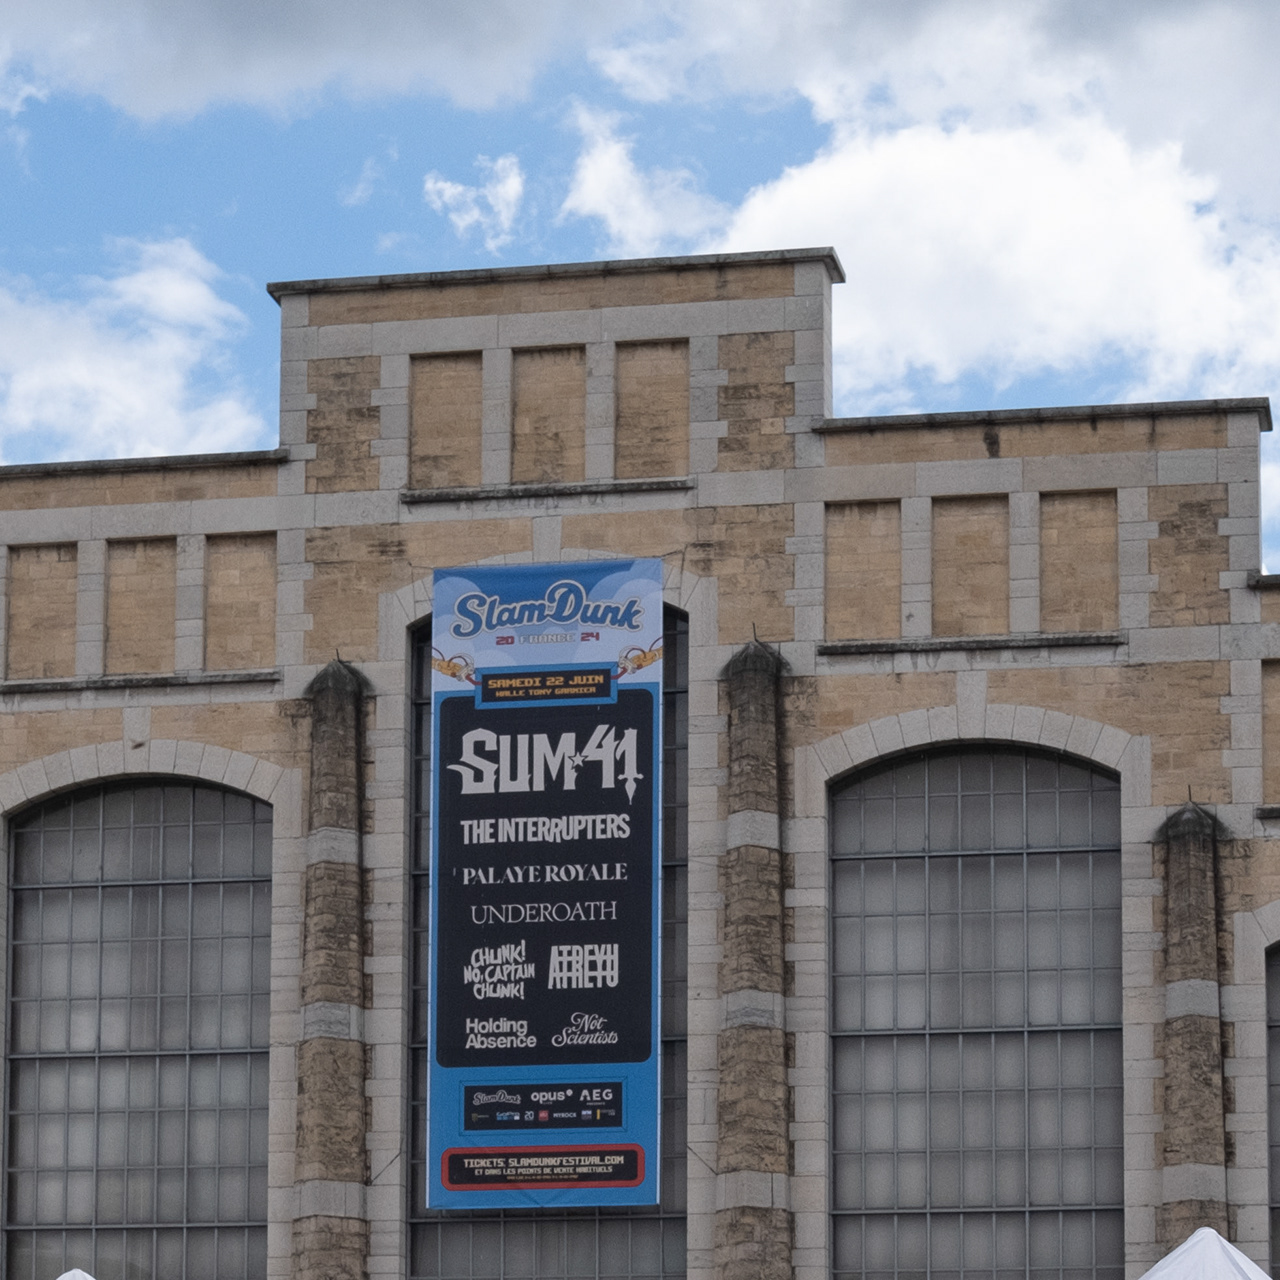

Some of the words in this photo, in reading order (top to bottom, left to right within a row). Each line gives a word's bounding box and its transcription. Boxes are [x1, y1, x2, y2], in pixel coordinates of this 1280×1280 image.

[496, 636, 515, 645] 20
[520, 633, 576, 644] FRANCE
[580, 632, 600, 641] 24
[488, 677, 542, 689] SAMEDI
[546, 676, 564, 686] 22
[569, 675, 604, 685] JUIN
[495, 689, 525, 698] HALLE
[528, 688, 552, 696] TONY
[554, 687, 596, 695] GARNIER
[447, 728, 576, 794] SUM
[580, 724, 643, 805] 41
[460, 819, 496, 845] THE
[498, 813, 631, 844] INTERRUPTERS
[462, 865, 541, 885] PALAYE
[544, 862, 628, 883] ROYALE
[471, 901, 617, 924] UNDEROATH
[470, 939, 526, 968] CHUNK!
[463, 965, 483, 985] NO,
[485, 963, 535, 983] CAPTAIN
[473, 981, 525, 1000] CHUNK!
[465, 1017, 528, 1036] Holding
[570, 1012, 608, 1032] Not
[465, 1033, 538, 1049] Absence
[551, 1026, 619, 1047] Scientists
[530, 1091, 566, 1104] opus
[579, 1089, 613, 1101] AEG
[508, 1156, 624, 1168] SLAMDUNKFESTIVAL.COM
[543, 1166, 552, 1174] DE
